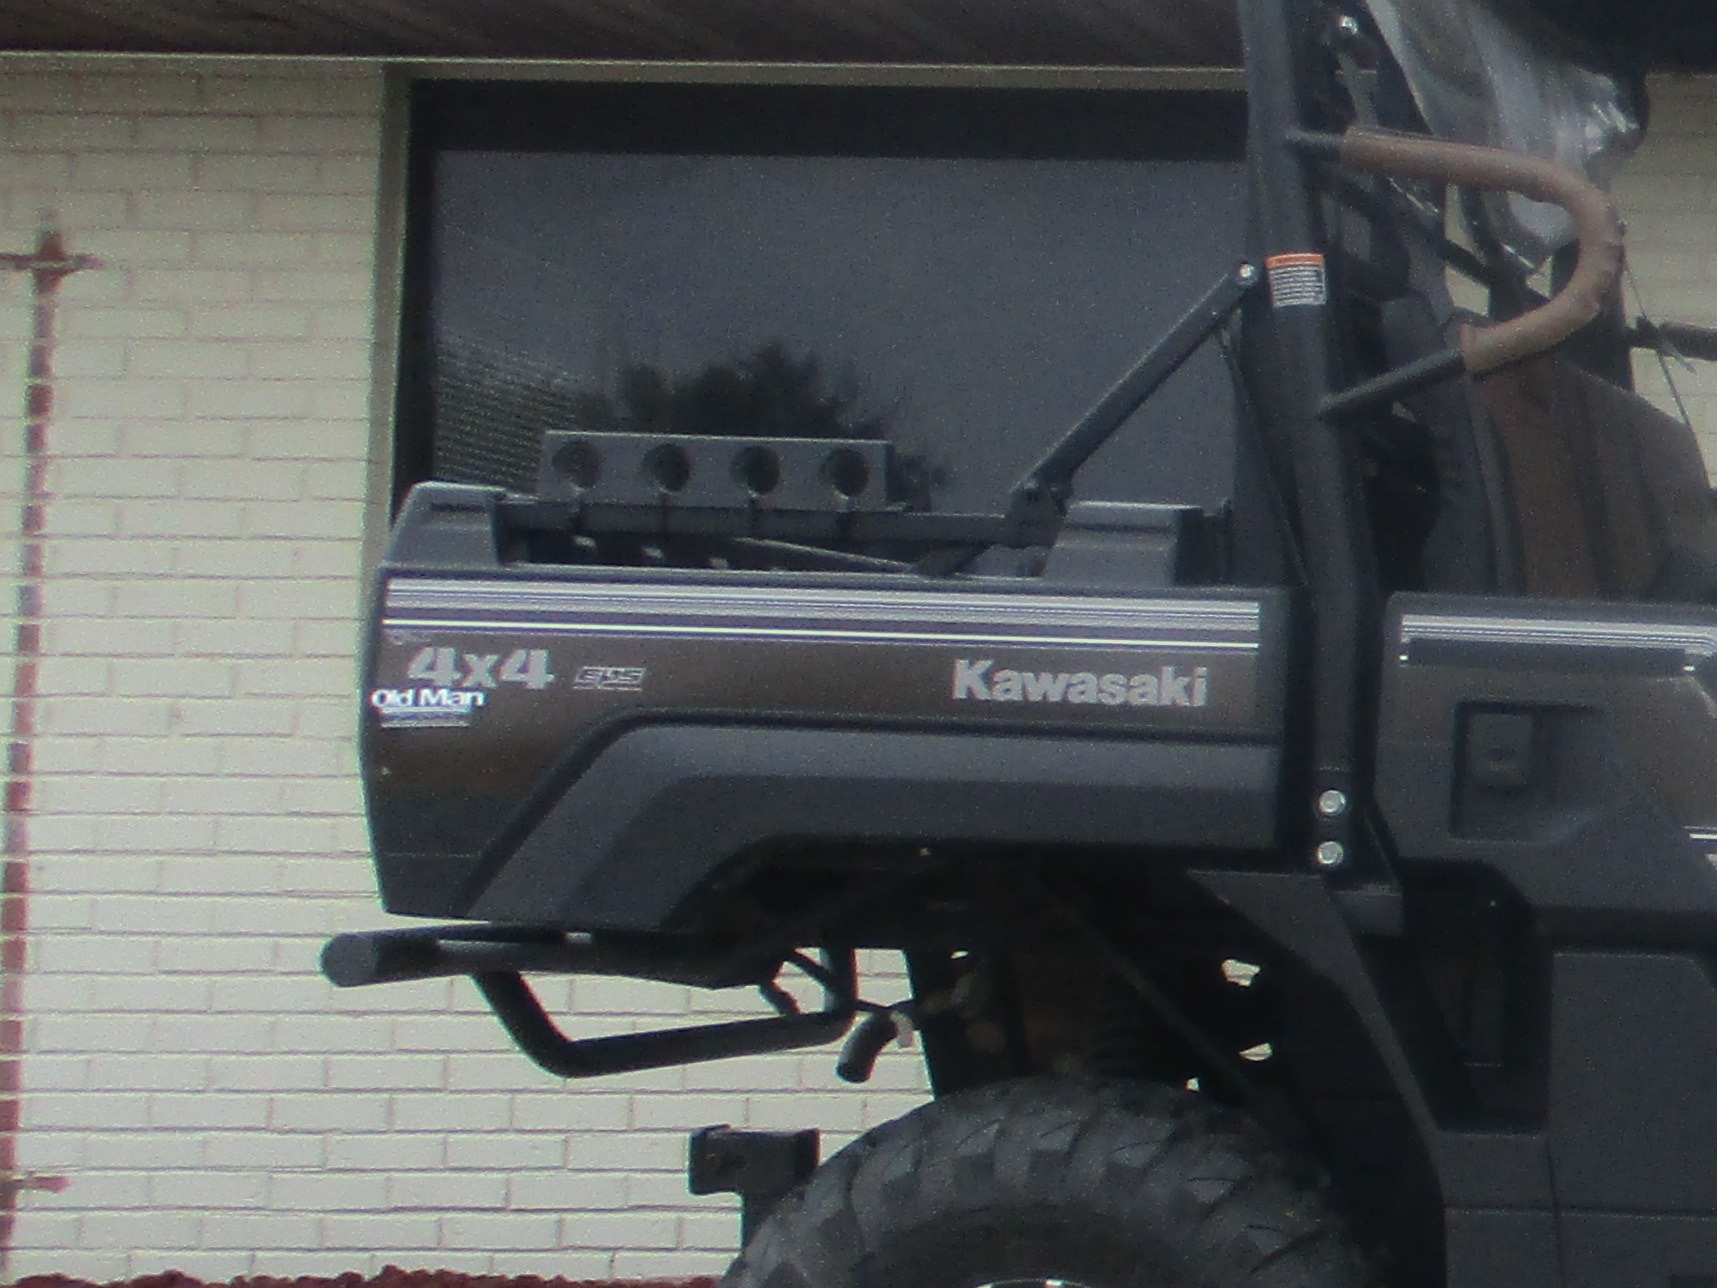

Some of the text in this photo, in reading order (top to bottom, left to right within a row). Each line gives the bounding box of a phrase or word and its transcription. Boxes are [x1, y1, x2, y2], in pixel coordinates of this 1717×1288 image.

[407, 647, 554, 689] 4x4
[951, 659, 1208, 707] Kawasaki
[371, 688, 487, 708] Old Man
